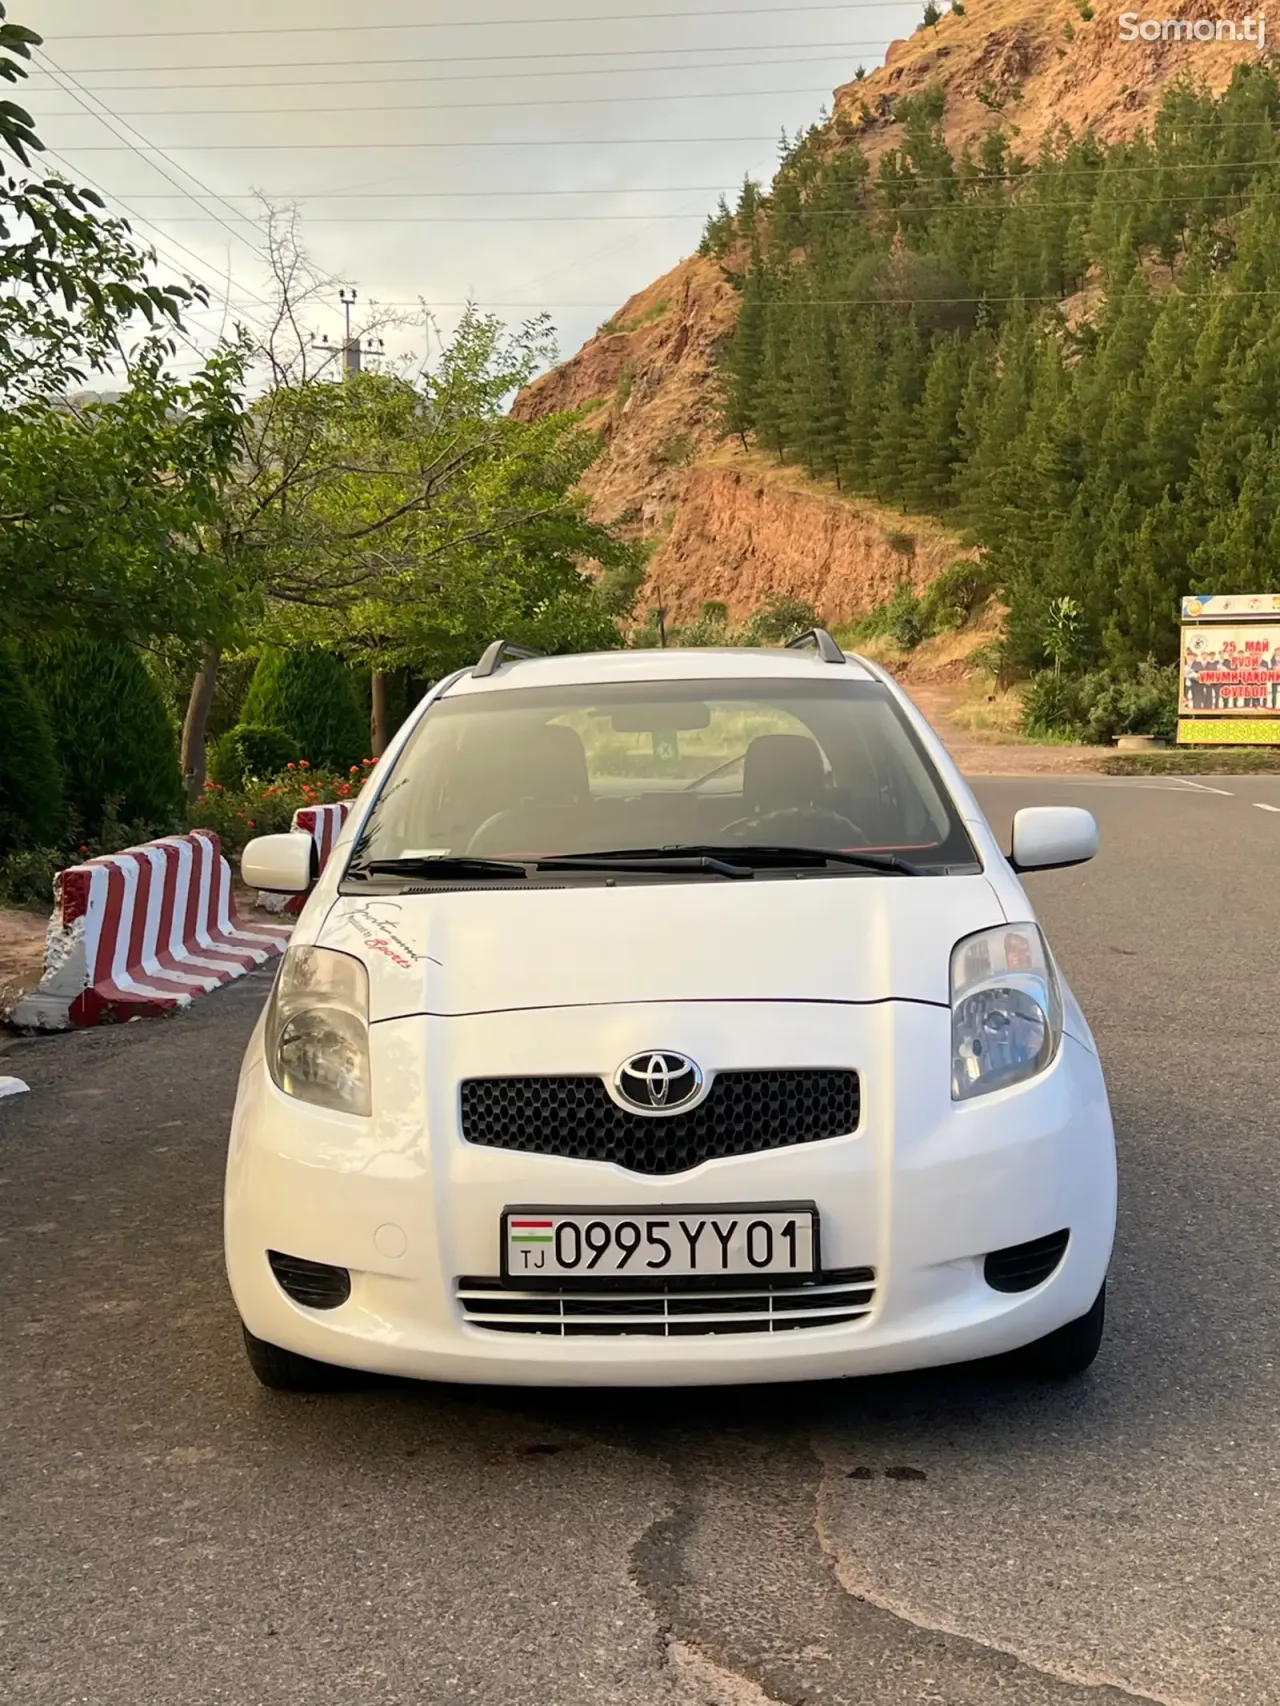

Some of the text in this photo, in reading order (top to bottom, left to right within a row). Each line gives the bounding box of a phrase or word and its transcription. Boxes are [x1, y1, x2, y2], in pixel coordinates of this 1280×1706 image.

[1222, 638, 1269, 653] 25 МАЙ
[1221, 686, 1267, 697] ФУТБОЛ
[364, 938, 411, 969] Sports
[554, 1219, 797, 1269] 0995YY01
[521, 1250, 545, 1268] TJ
